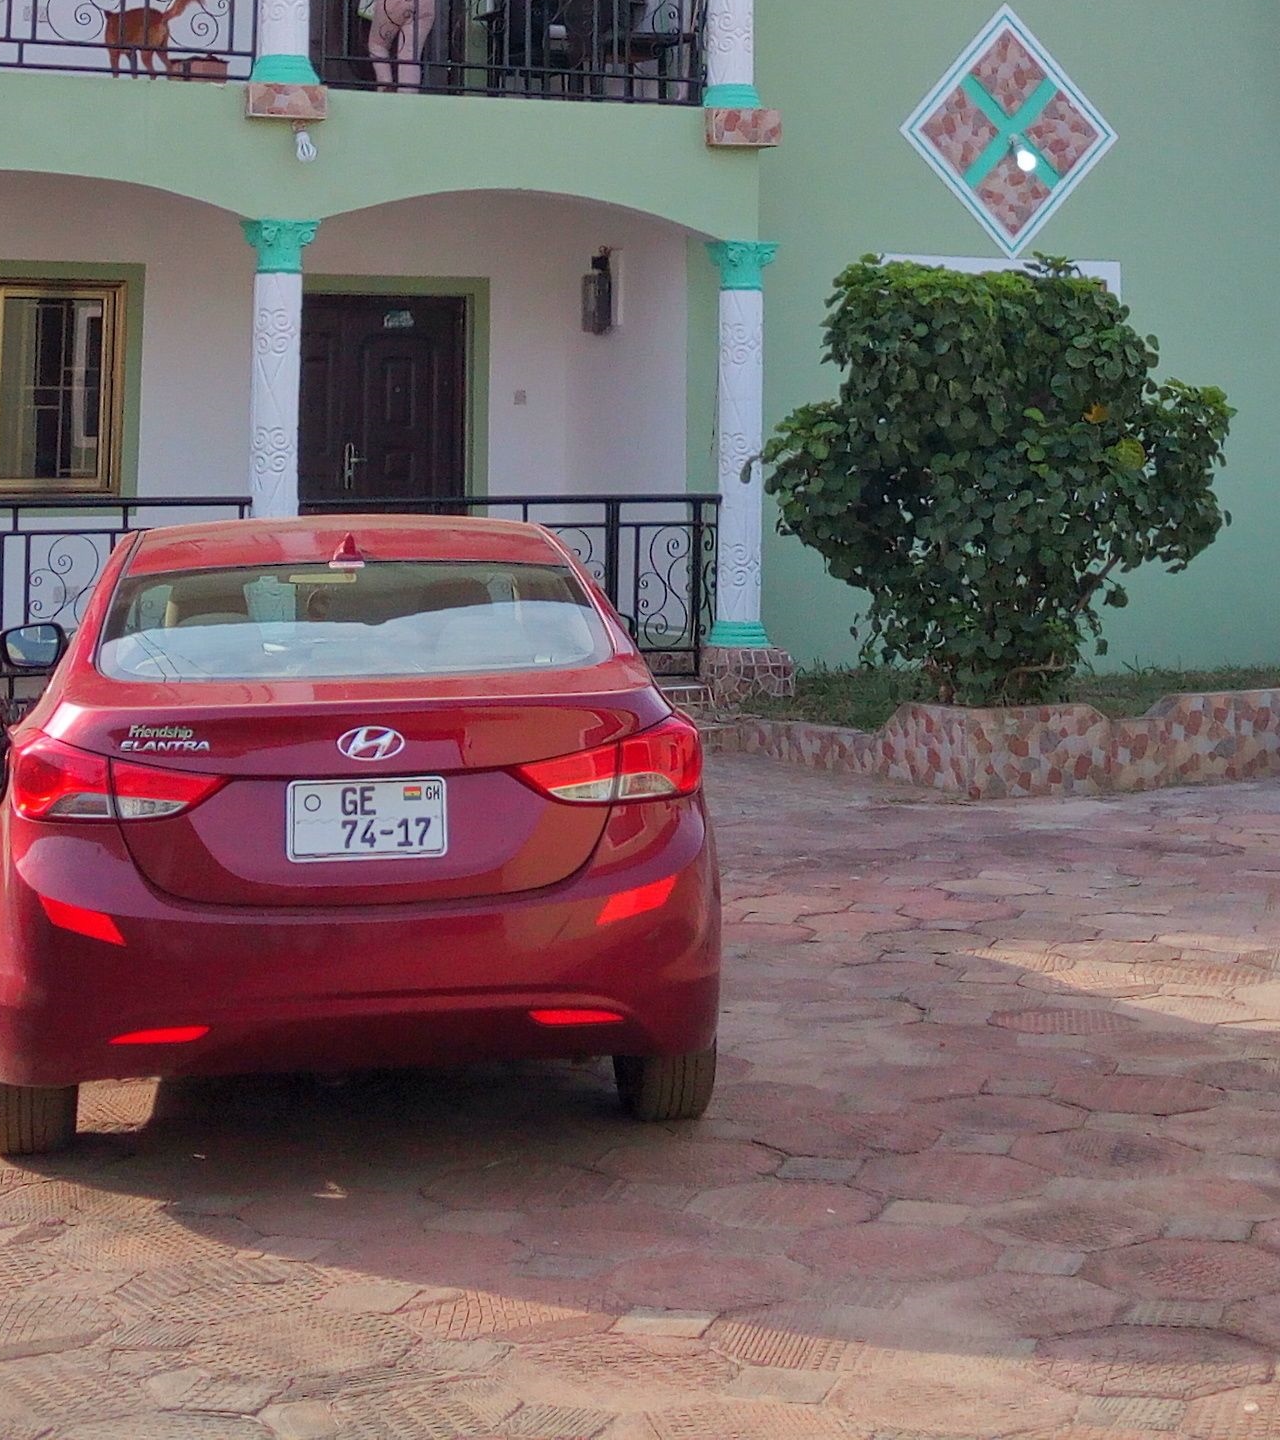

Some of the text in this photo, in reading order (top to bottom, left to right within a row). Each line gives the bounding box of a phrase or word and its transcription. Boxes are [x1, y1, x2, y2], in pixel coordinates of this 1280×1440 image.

[128, 724, 194, 740] Friendship
[120, 740, 211, 753] ELANTRA
[340, 785, 441, 816] GE GH
[341, 817, 432, 849] 74-17
